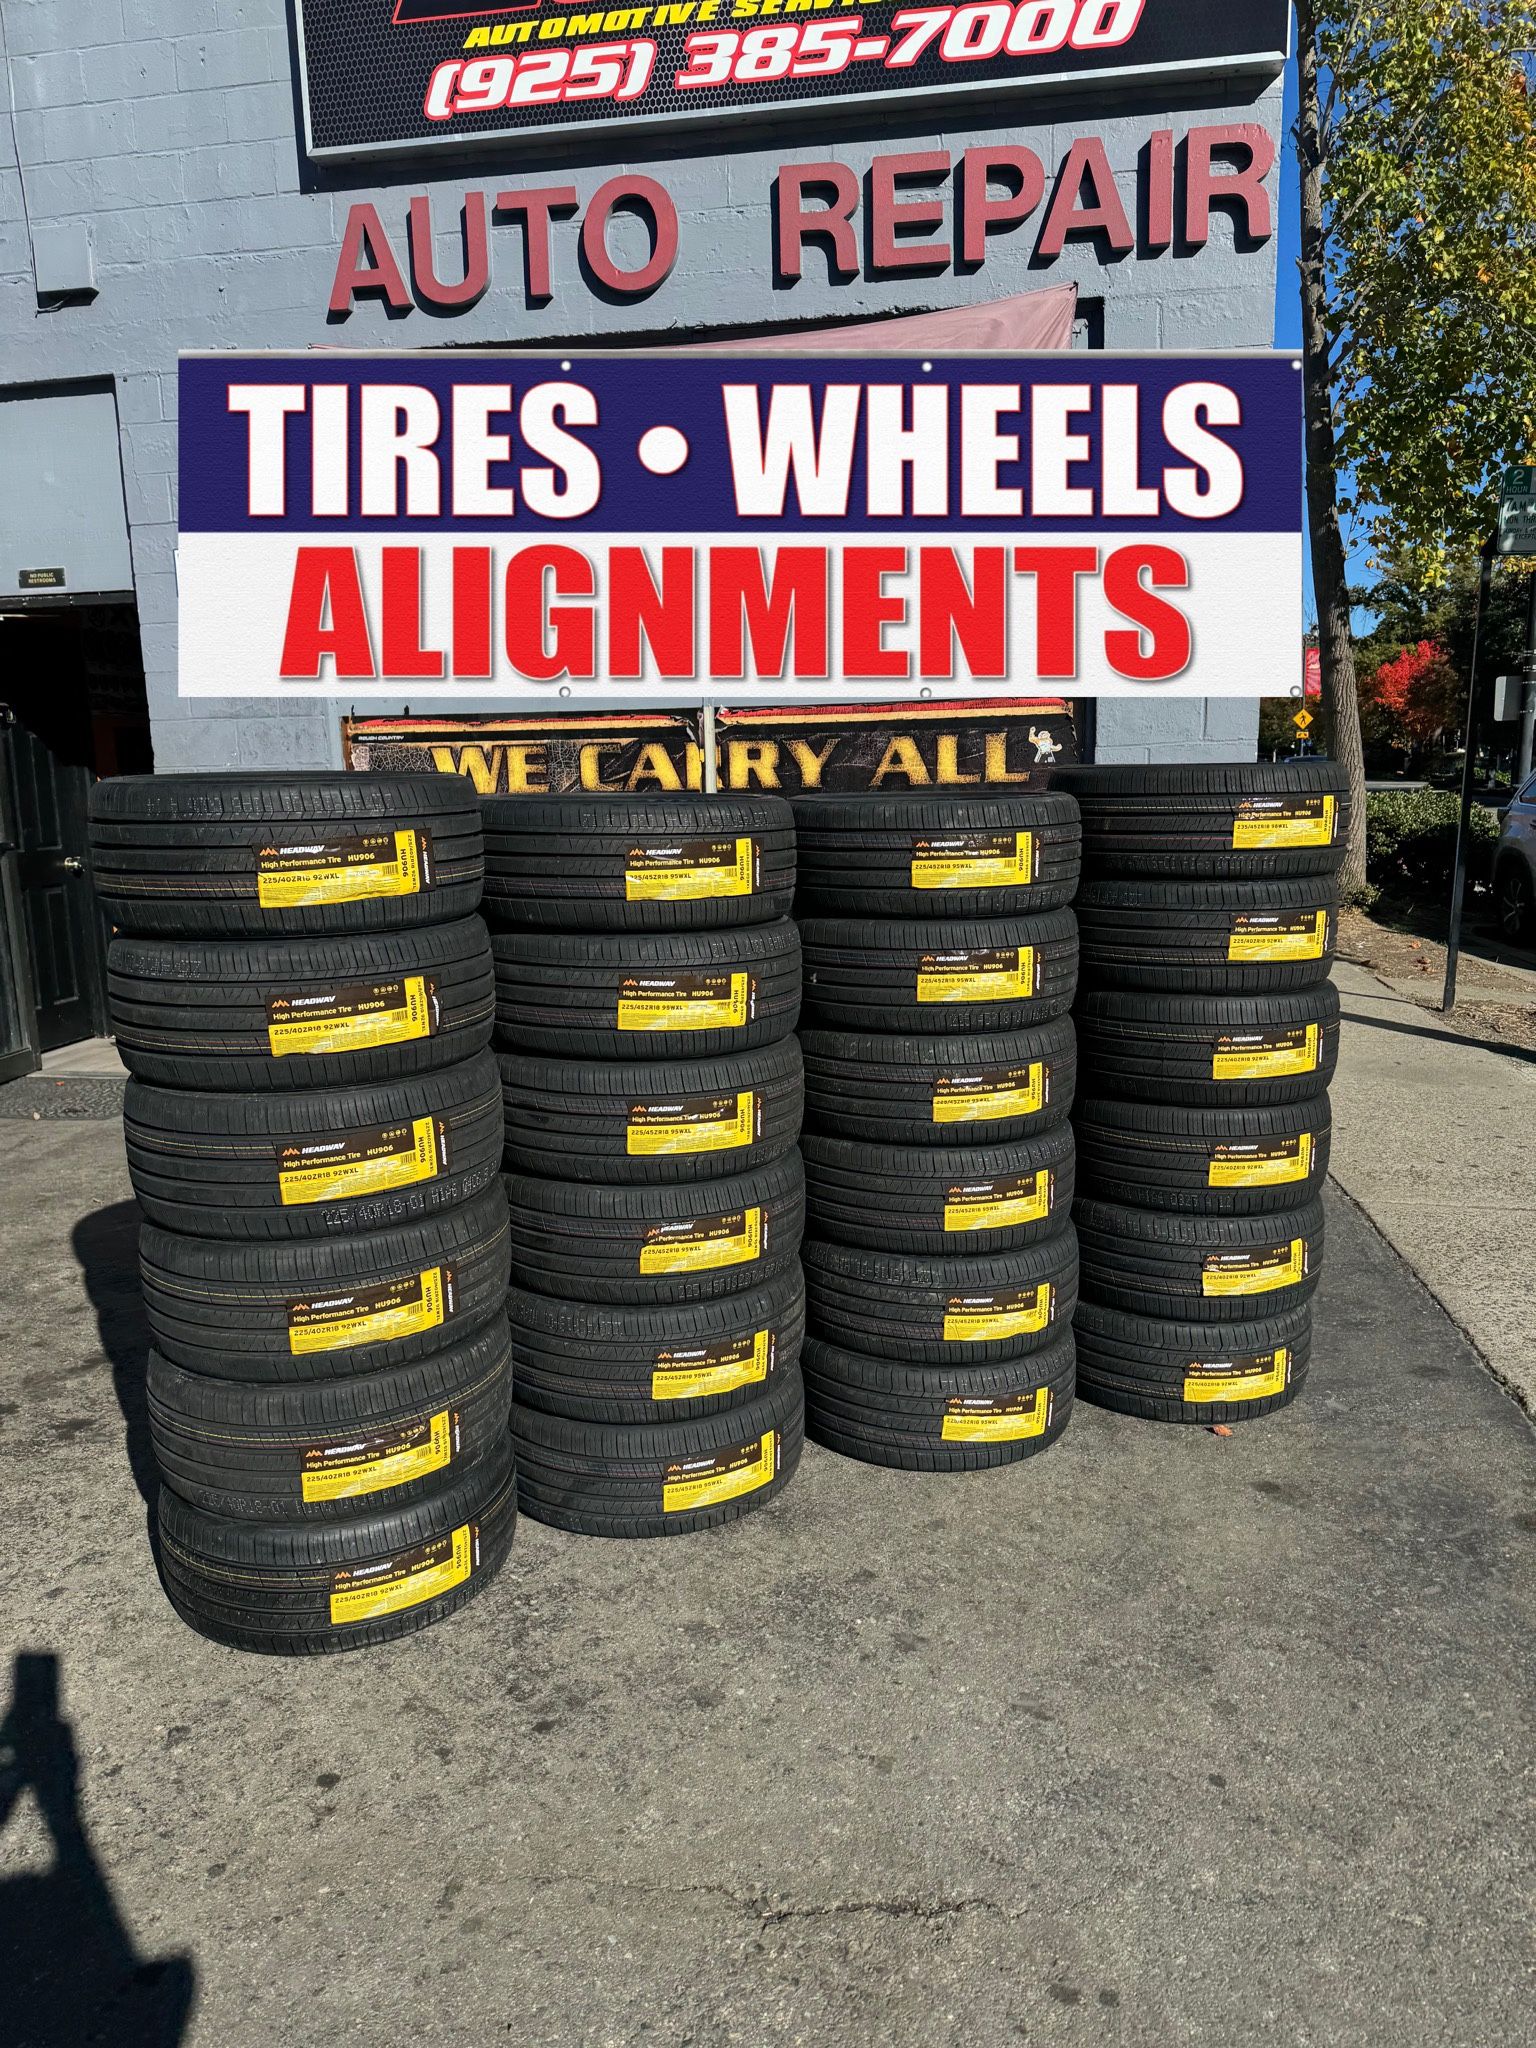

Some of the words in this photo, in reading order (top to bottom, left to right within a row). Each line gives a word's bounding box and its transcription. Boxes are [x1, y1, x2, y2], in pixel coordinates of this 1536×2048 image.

[463, 0, 720, 48] AUTOMOTIVE
[424, 41, 656, 120] (925)
[675, 0, 1142, 88] 385-7000
[328, 174, 680, 314] AUTO
[778, 122, 1274, 278] REPAIR
[227, 381, 601, 519] TIRES
[721, 381, 1244, 519] WHEELS
[1512, 469, 1525, 485] 2
[279, 543, 1192, 682] ALIGNMENTS
[430, 744, 550, 794] WE
[869, 732, 1031, 787] ALL
[280, 845, 325, 854] HEADWAY
[646, 848, 682, 856] HEADWAY
[280, 858, 325, 867] Performance
[348, 853, 375, 861] HU906
[400, 849, 408, 877] HU906
[291, 995, 336, 1006] HEADWAY
[291, 1009, 337, 1018] Performance
[358, 1001, 385, 1010] HU906
[410, 995, 418, 1021] HU906
[324, 1022, 349, 1030] 92WXL
[302, 1142, 345, 1154] HEADWAY
[418, 1136, 426, 1163] HU906
[284, 1160, 300, 1168] High
[302, 1155, 346, 1165] Performance
[347, 1151, 361, 1159] Tire
[367, 1145, 394, 1155] HU906
[334, 1168, 359, 1177] 92WXL
[311, 1309, 354, 1320] Performance
[375, 1297, 401, 1309] HU906
[312, 1297, 354, 1309] HEADWAY
[342, 1321, 367, 1329] 92WXL
[674, 1350, 706, 1358] HEADWAY
[307, 1461, 323, 1469] High
[323, 1455, 365, 1466] Performance
[386, 1443, 411, 1455] HU906
[324, 1443, 366, 1455] HEADWAY
[353, 1466, 377, 1475] 92WXL
[683, 1459, 715, 1470] HEADWAY
[681, 1469, 715, 1480] Performance
[335, 1581, 351, 1590] High
[352, 1574, 393, 1587] Performance
[395, 1569, 406, 1577] Tire
[411, 1558, 435, 1572] HU906
[353, 1562, 393, 1576] HEADWAY
[380, 1584, 403, 1594] 92WXL
